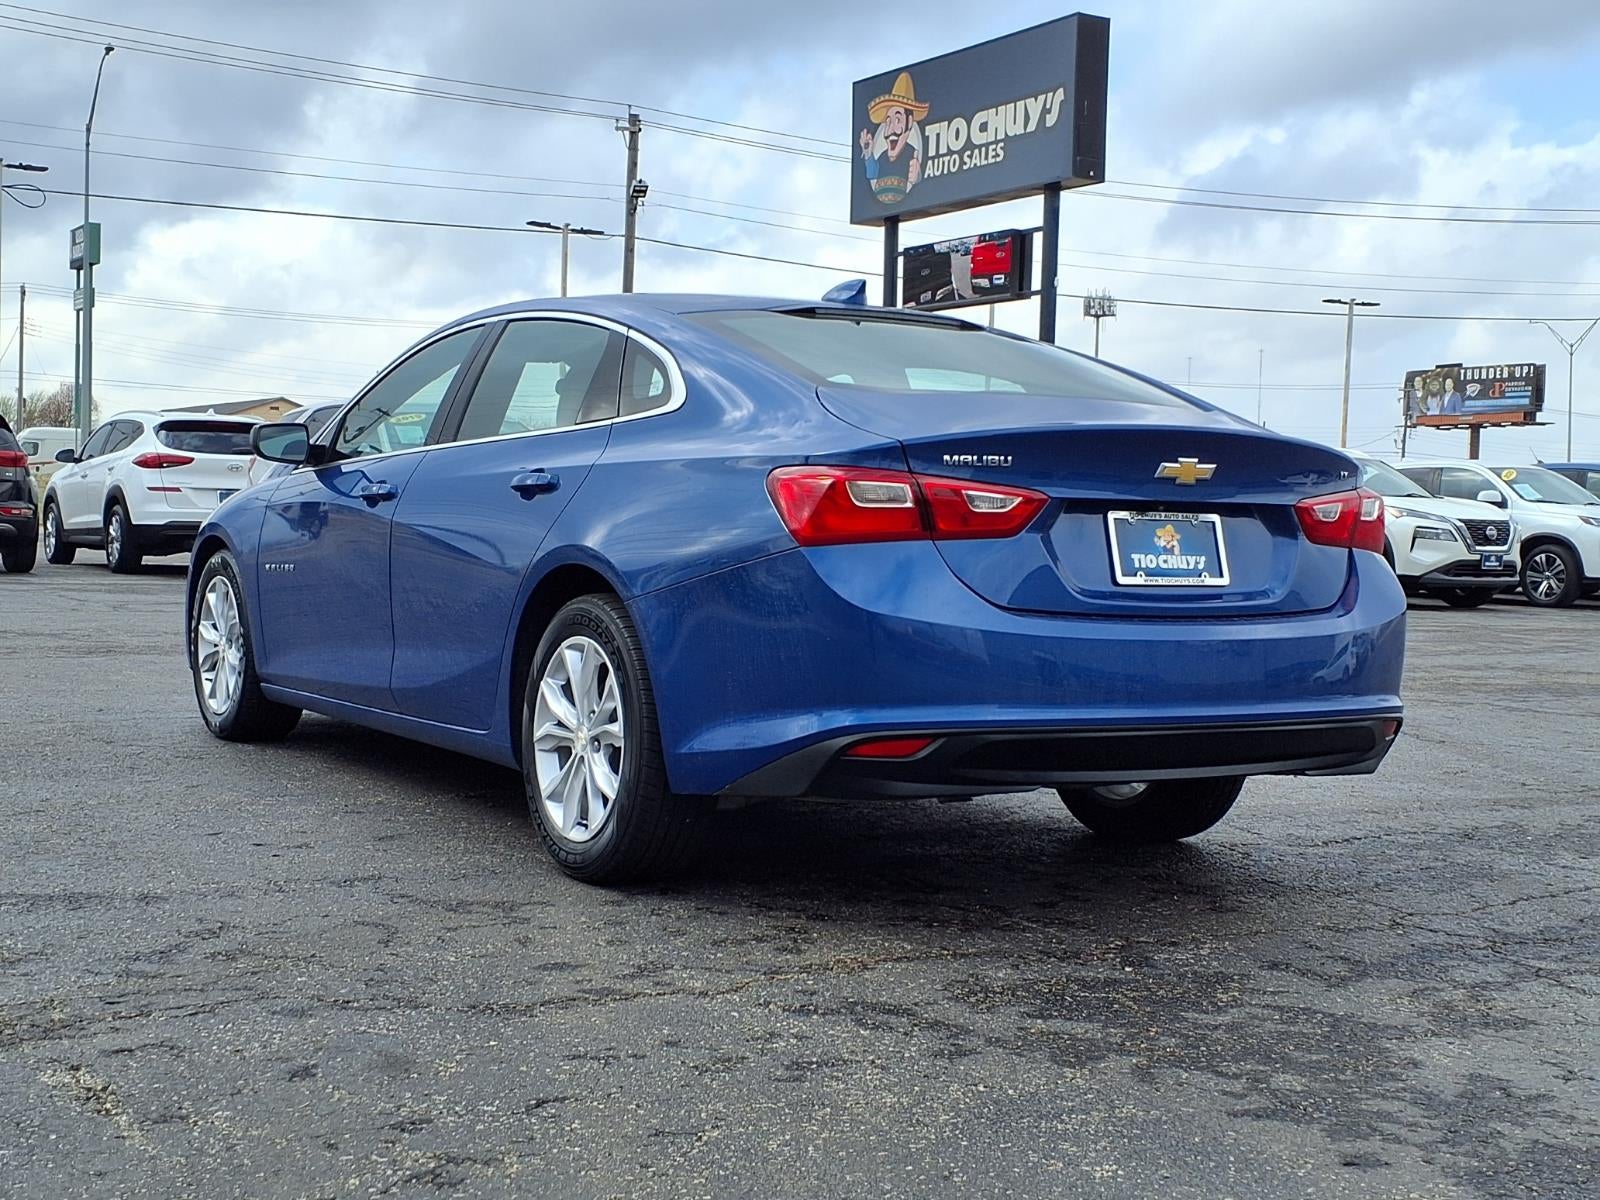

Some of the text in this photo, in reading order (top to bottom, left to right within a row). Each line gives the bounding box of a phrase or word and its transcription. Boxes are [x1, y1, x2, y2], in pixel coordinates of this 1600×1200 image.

[925, 87, 1065, 156] TIO CHUY'S
[924, 142, 1005, 178] AUTO SALES
[1460, 365, 1533, 380] THUNDER UP!
[943, 454, 1013, 467] MALIBU
[1131, 553, 1206, 569] TIO CHUY'S
